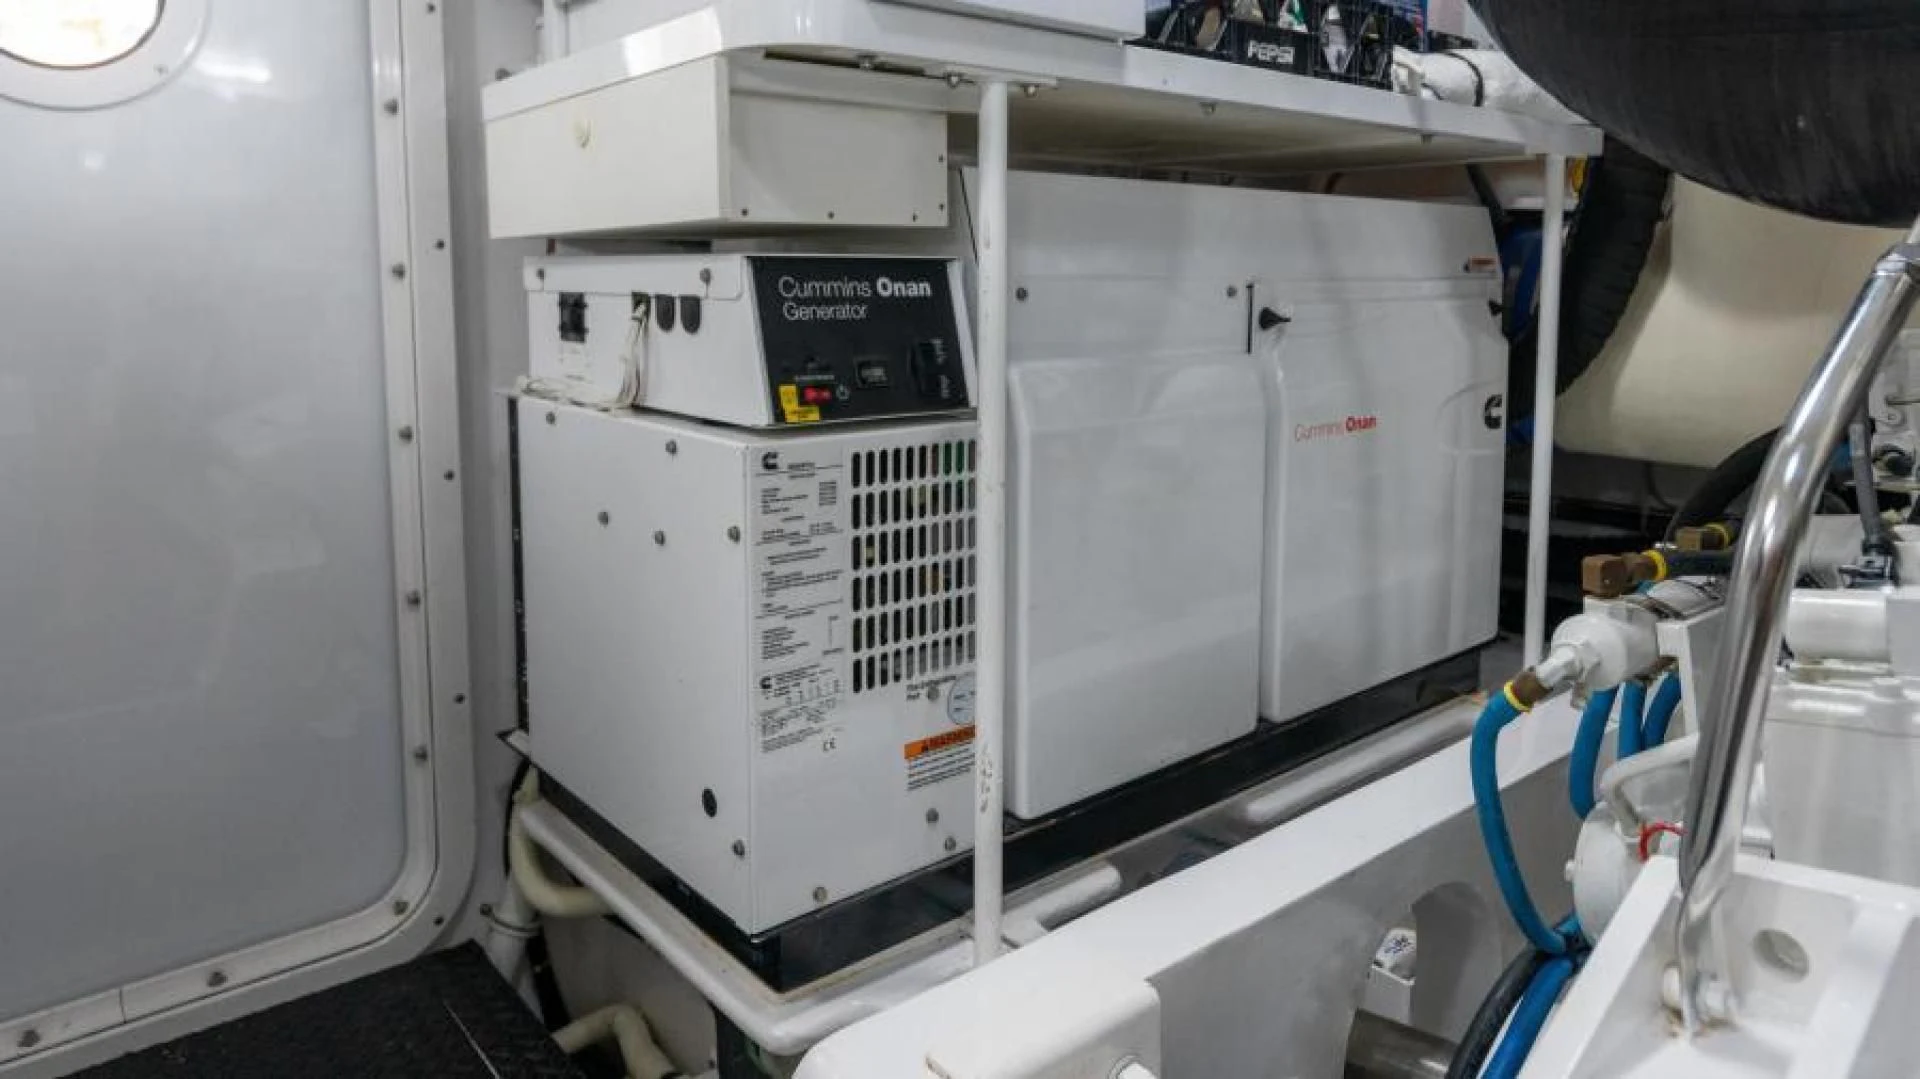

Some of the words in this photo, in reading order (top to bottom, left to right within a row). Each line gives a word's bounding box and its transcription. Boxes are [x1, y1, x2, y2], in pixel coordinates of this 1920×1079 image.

[1247, 40, 1295, 64] PEPSI
[778, 275, 872, 298] Cummins
[876, 276, 932, 297] Onan
[782, 302, 868, 321] Generator
